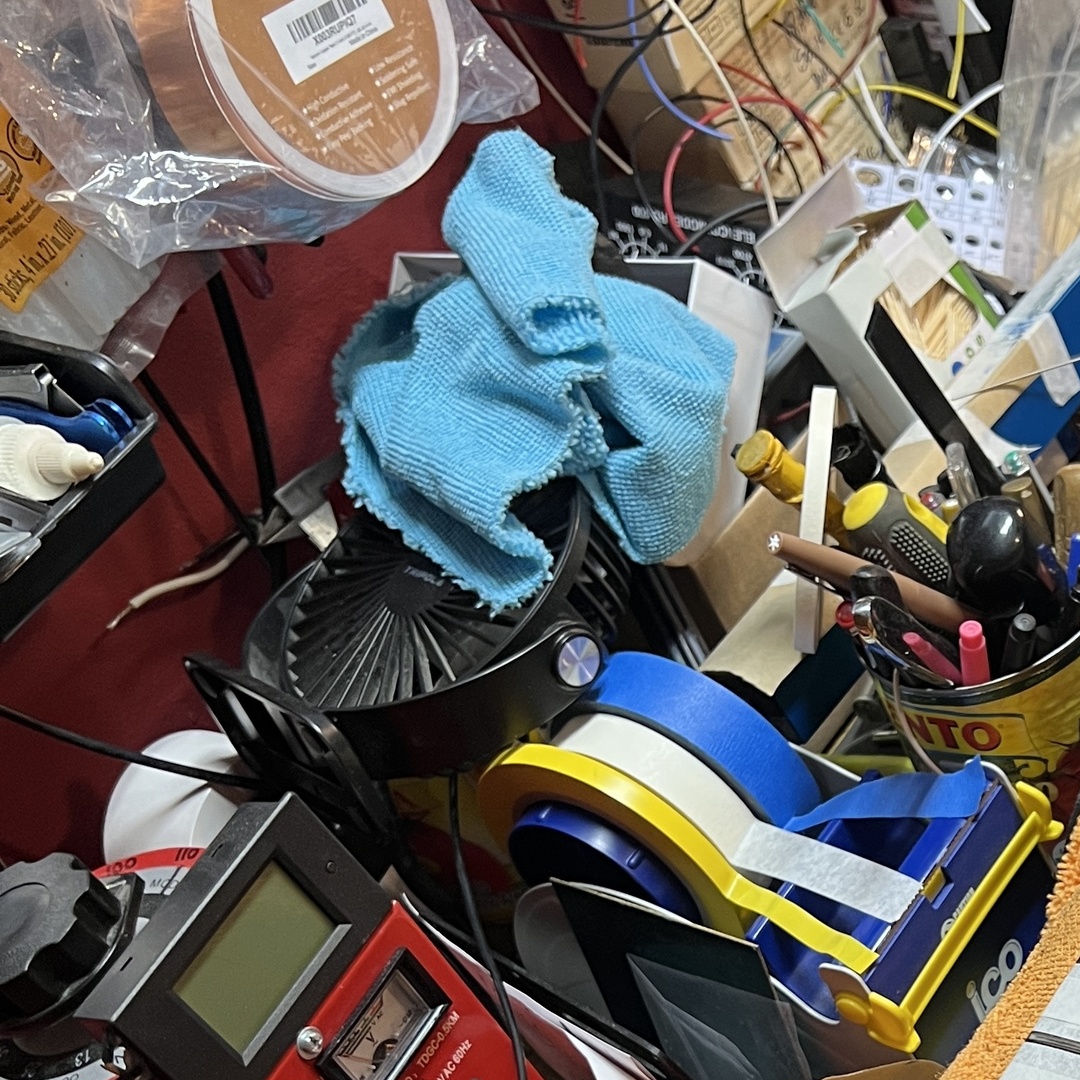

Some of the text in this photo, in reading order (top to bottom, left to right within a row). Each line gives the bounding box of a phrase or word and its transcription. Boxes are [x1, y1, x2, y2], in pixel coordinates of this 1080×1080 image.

[174, 848, 199, 861] 110
[416, 1010, 462, 1070] TDGC-0.5KM
[451, 1038, 473, 1065] 60Hz
